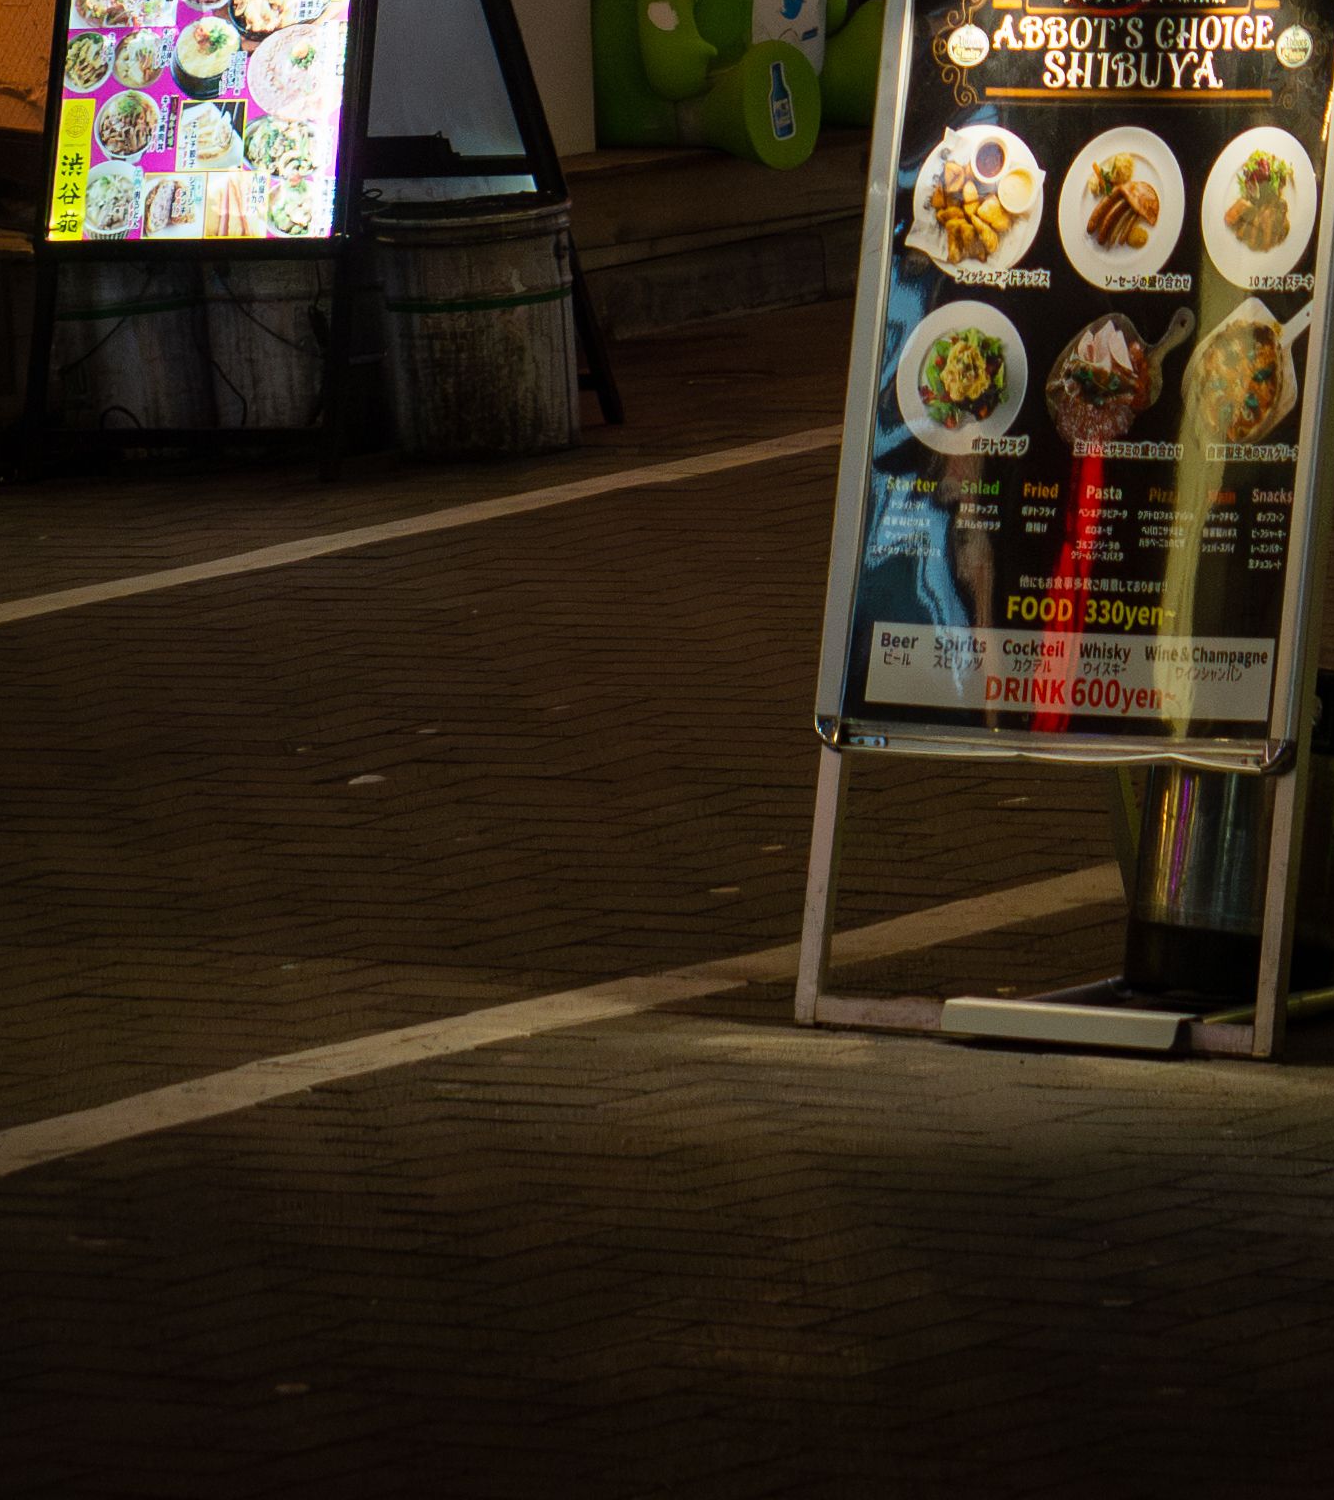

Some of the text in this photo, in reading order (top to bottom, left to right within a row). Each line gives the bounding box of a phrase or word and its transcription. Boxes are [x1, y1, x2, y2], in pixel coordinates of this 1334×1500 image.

[992, 14, 1144, 51] ABBOT'S
[1155, 14, 1276, 51] CHOICE
[1042, 50, 1224, 90] SHIBUYA
[56, 152, 84, 233] 渋谷苑
[886, 476, 938, 493] Starter
[960, 480, 1000, 496] Salad
[1023, 482, 1060, 499] Fried
[1085, 485, 1123, 501] Pasta
[1251, 488, 1294, 504] Snacks
[1006, 596, 1073, 623] FOOD
[880, 631, 919, 653] Beer
[933, 635, 987, 656] Spirits
[1079, 642, 1132, 665] Whisky
[1190, 646, 1269, 667] Champagne
[882, 650, 912, 668] ビール
[1011, 657, 1052, 675] カクテル
[985, 675, 1066, 706] DRINK
